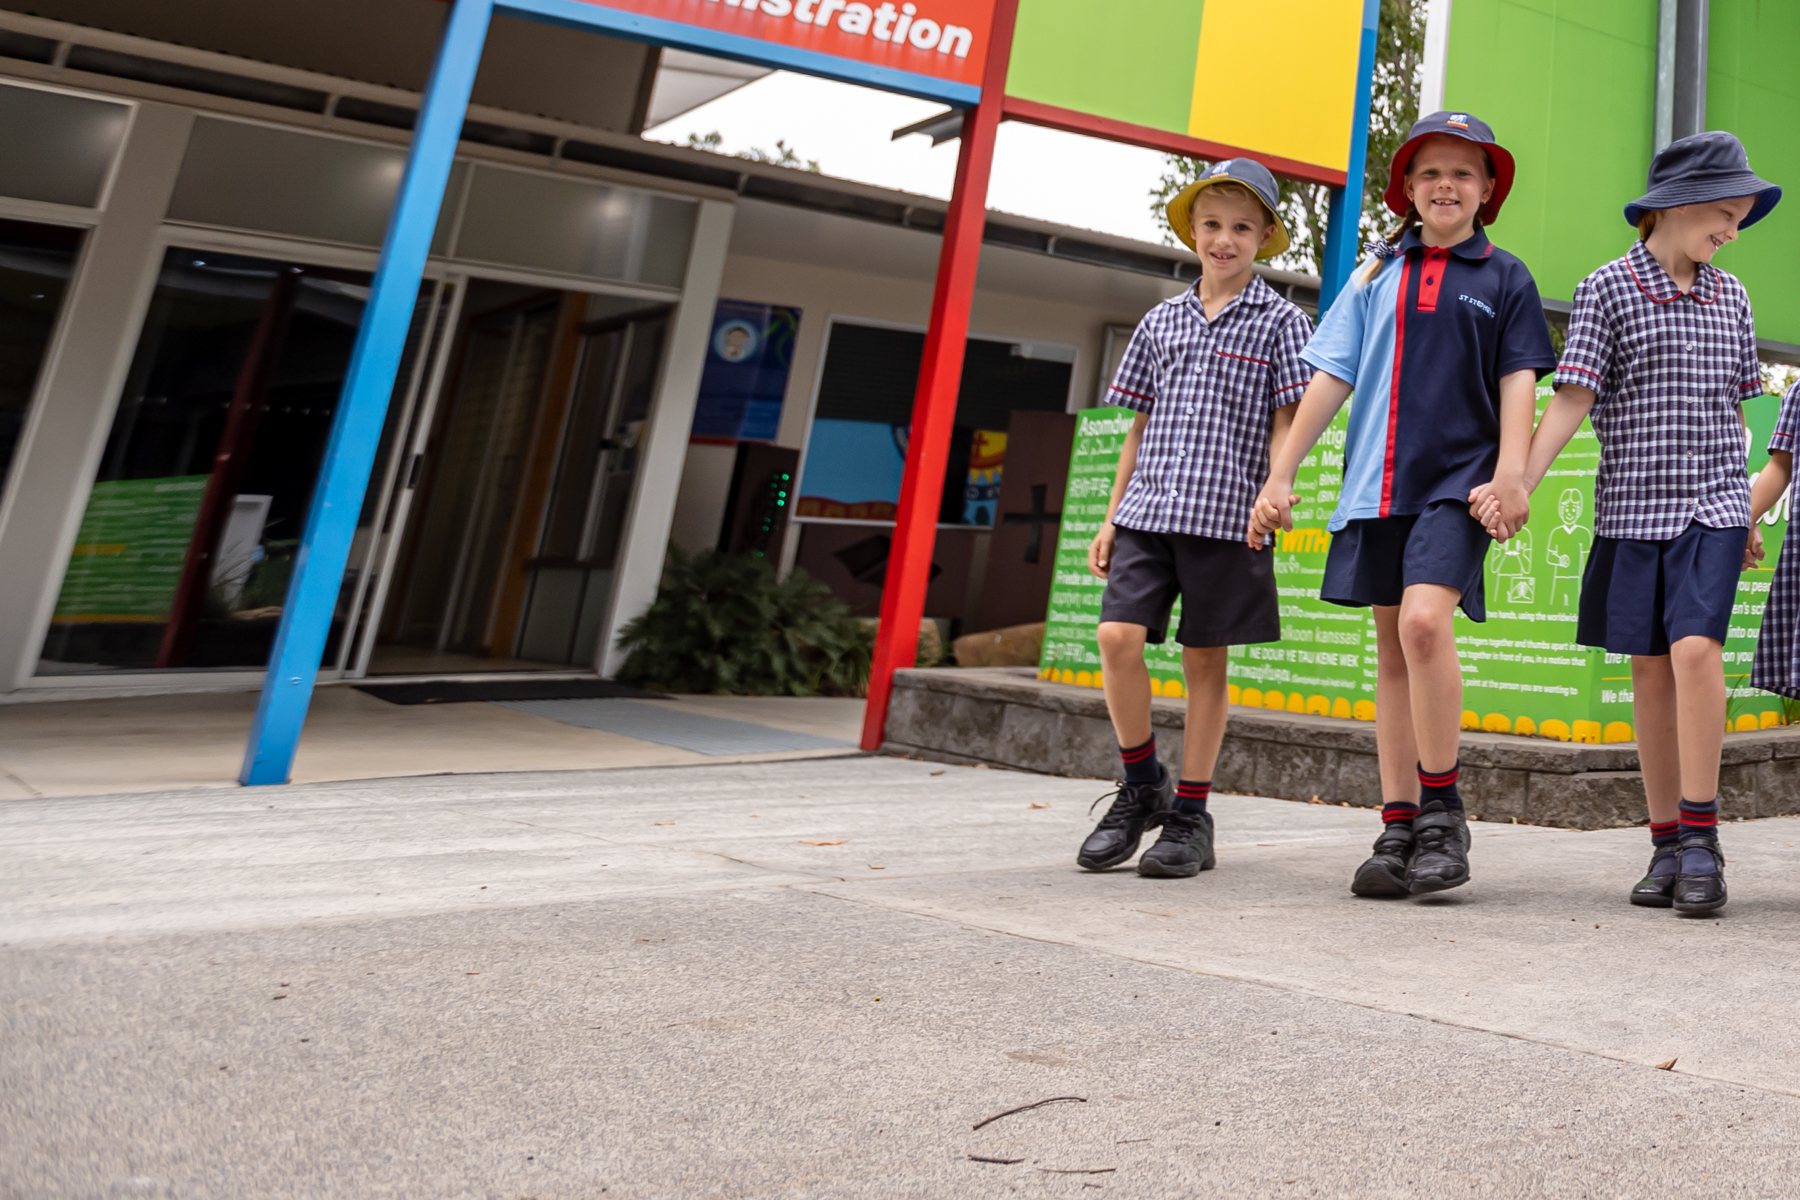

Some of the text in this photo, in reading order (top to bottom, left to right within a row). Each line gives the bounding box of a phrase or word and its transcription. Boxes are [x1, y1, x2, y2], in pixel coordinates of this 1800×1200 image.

[1282, 528, 1332, 553] WITH
[1518, 611, 1535, 622] using
[1535, 612, 1546, 621] the
[1728, 624, 1746, 638] into
[1468, 635, 1488, 647] fingers
[1489, 638, 1513, 648] together
[1514, 639, 1526, 648] and
[1527, 640, 1550, 649] thumbs
[1550, 642, 1568, 652] apart
[1569, 642, 1576, 651] in
[1467, 650, 1492, 661] together
[1492, 651, 1499, 660] in
[1499, 652, 1514, 661] front
[1515, 653, 1522, 662] of
[1535, 654, 1542, 663] in
[1548, 656, 1571, 665] motion
[1571, 657, 1586, 666] that
[1736, 651, 1754, 666] you
[1466, 678, 1481, 687] point
[1481, 680, 1489, 688] at
[1489, 679, 1499, 688] the
[1499, 682, 1520, 691] person
[1520, 684, 1532, 692] you
[1543, 685, 1569, 696] wanting
[1569, 687, 1578, 696] to
[1601, 689, 1617, 704] We
